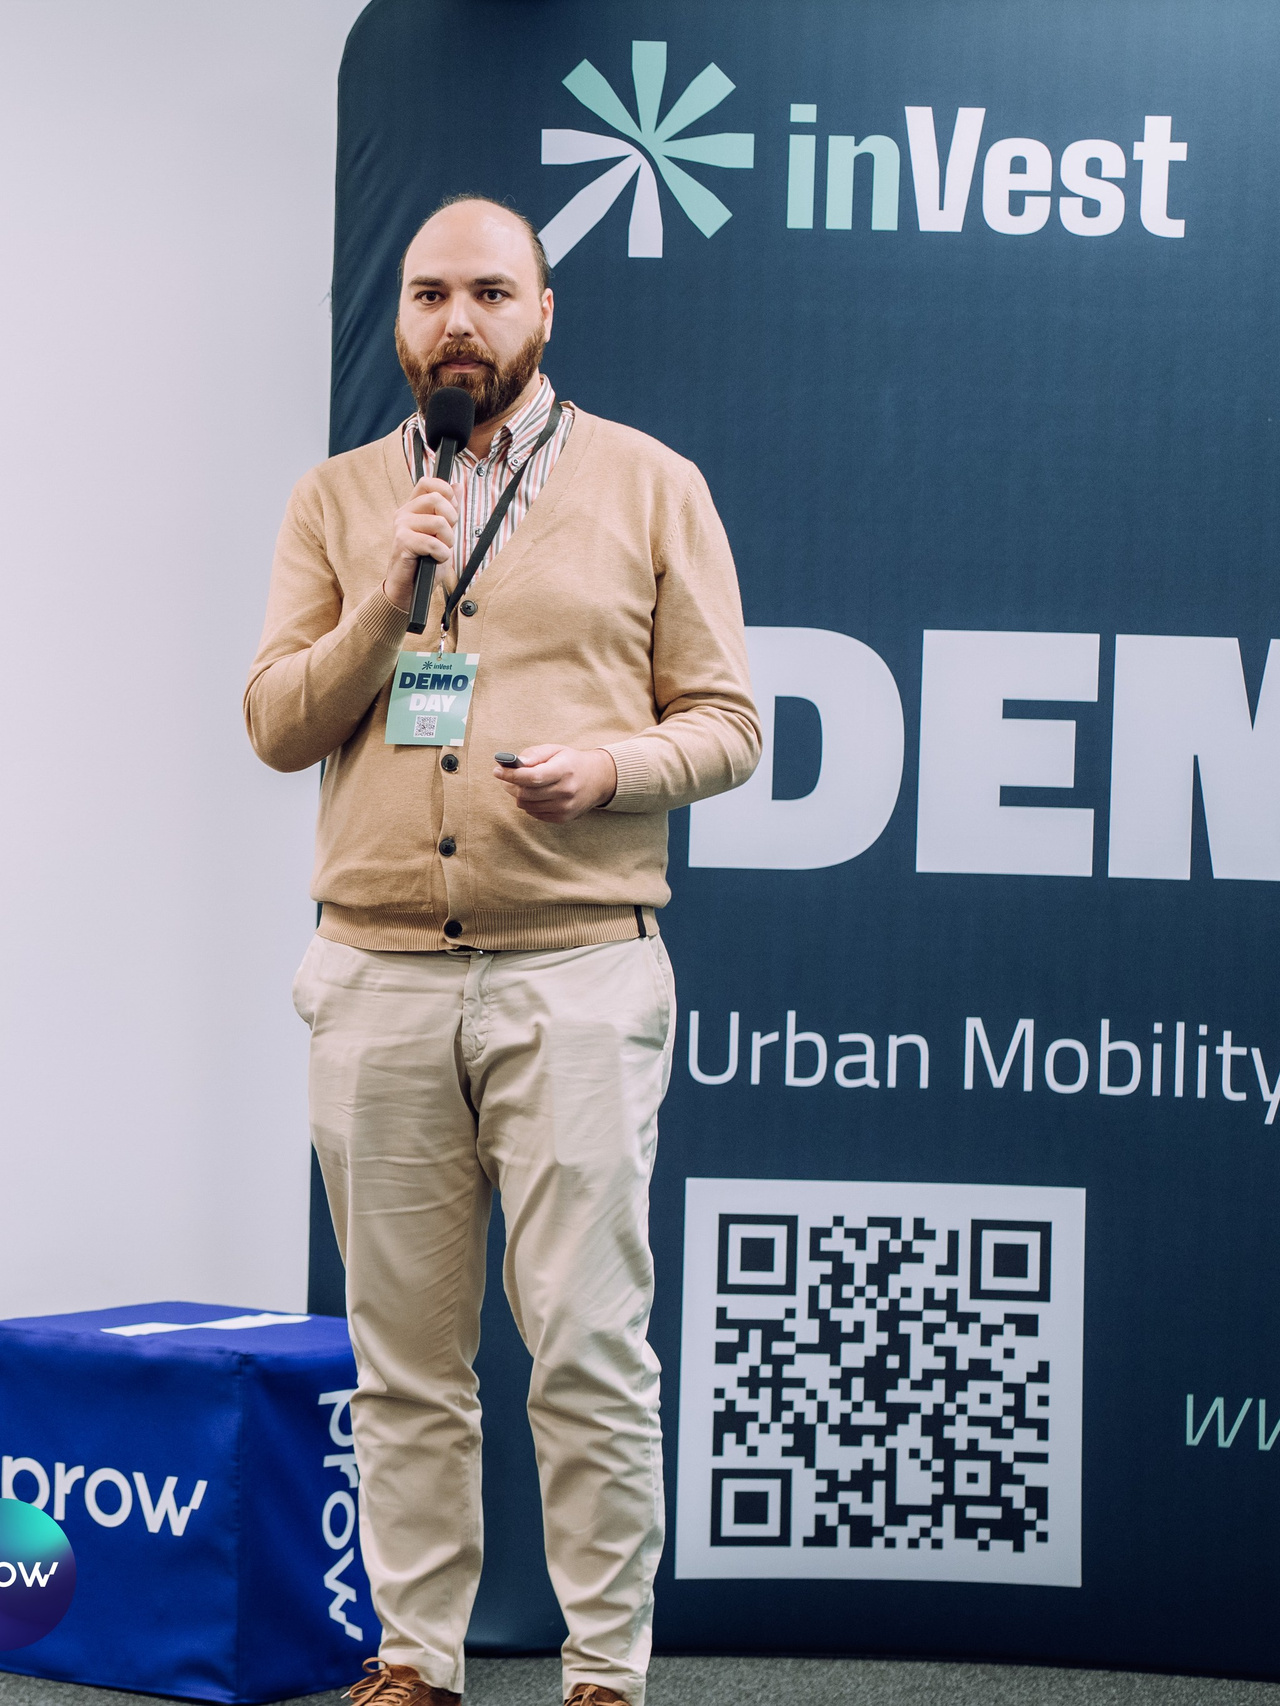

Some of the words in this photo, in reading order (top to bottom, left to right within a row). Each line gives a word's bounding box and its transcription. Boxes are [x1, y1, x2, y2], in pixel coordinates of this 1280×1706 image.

[786, 104, 1188, 238] inVest
[399, 672, 469, 691] DEMO
[409, 693, 457, 712] DAY
[688, 1010, 930, 1089] Urban
[963, 1016, 1280, 1125] Mobility
[1, 1455, 208, 1536] prow
[318, 1389, 363, 1642] prow
